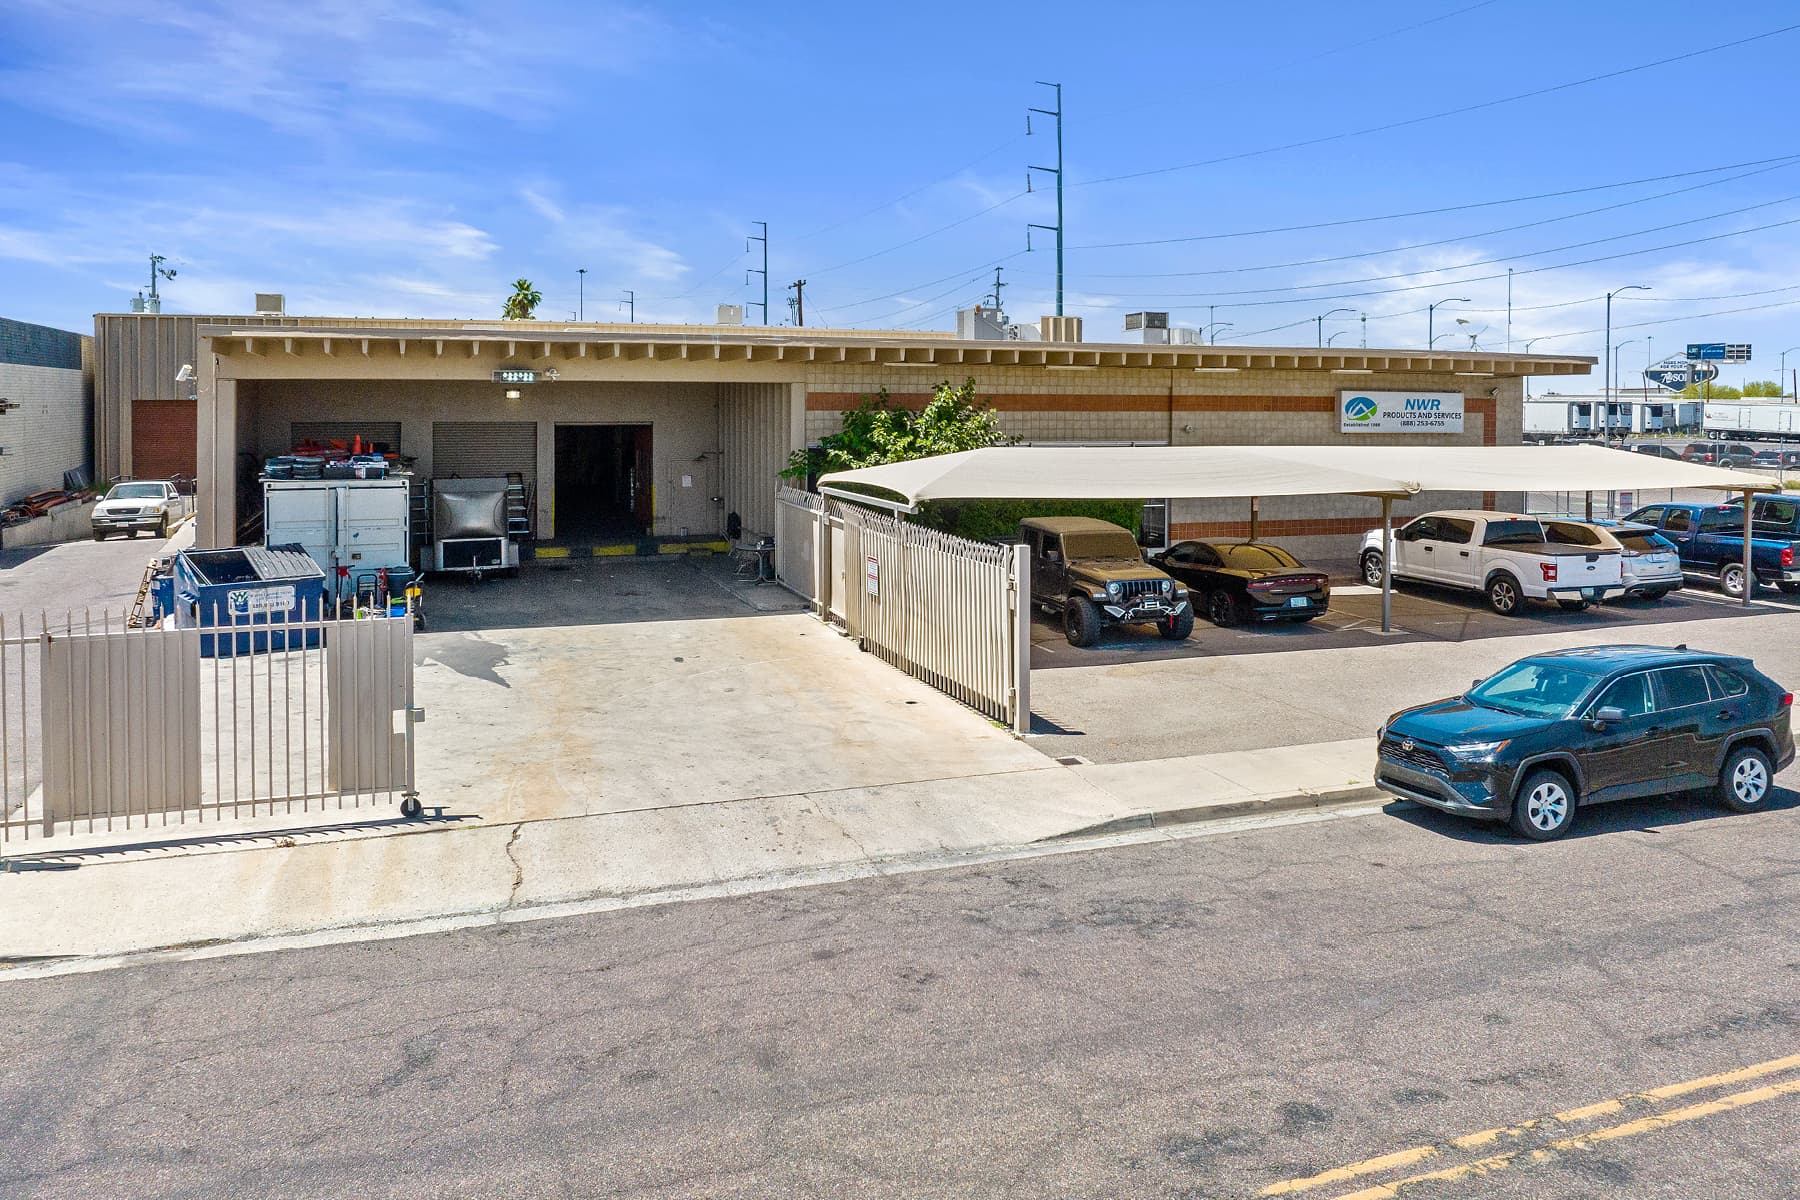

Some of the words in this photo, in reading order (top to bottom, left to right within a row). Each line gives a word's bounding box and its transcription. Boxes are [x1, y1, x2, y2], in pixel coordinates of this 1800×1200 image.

[1405, 398, 1441, 411] NWR
[1382, 411, 1417, 419] PRODUCTS
[1433, 412, 1462, 420] SERVICES
